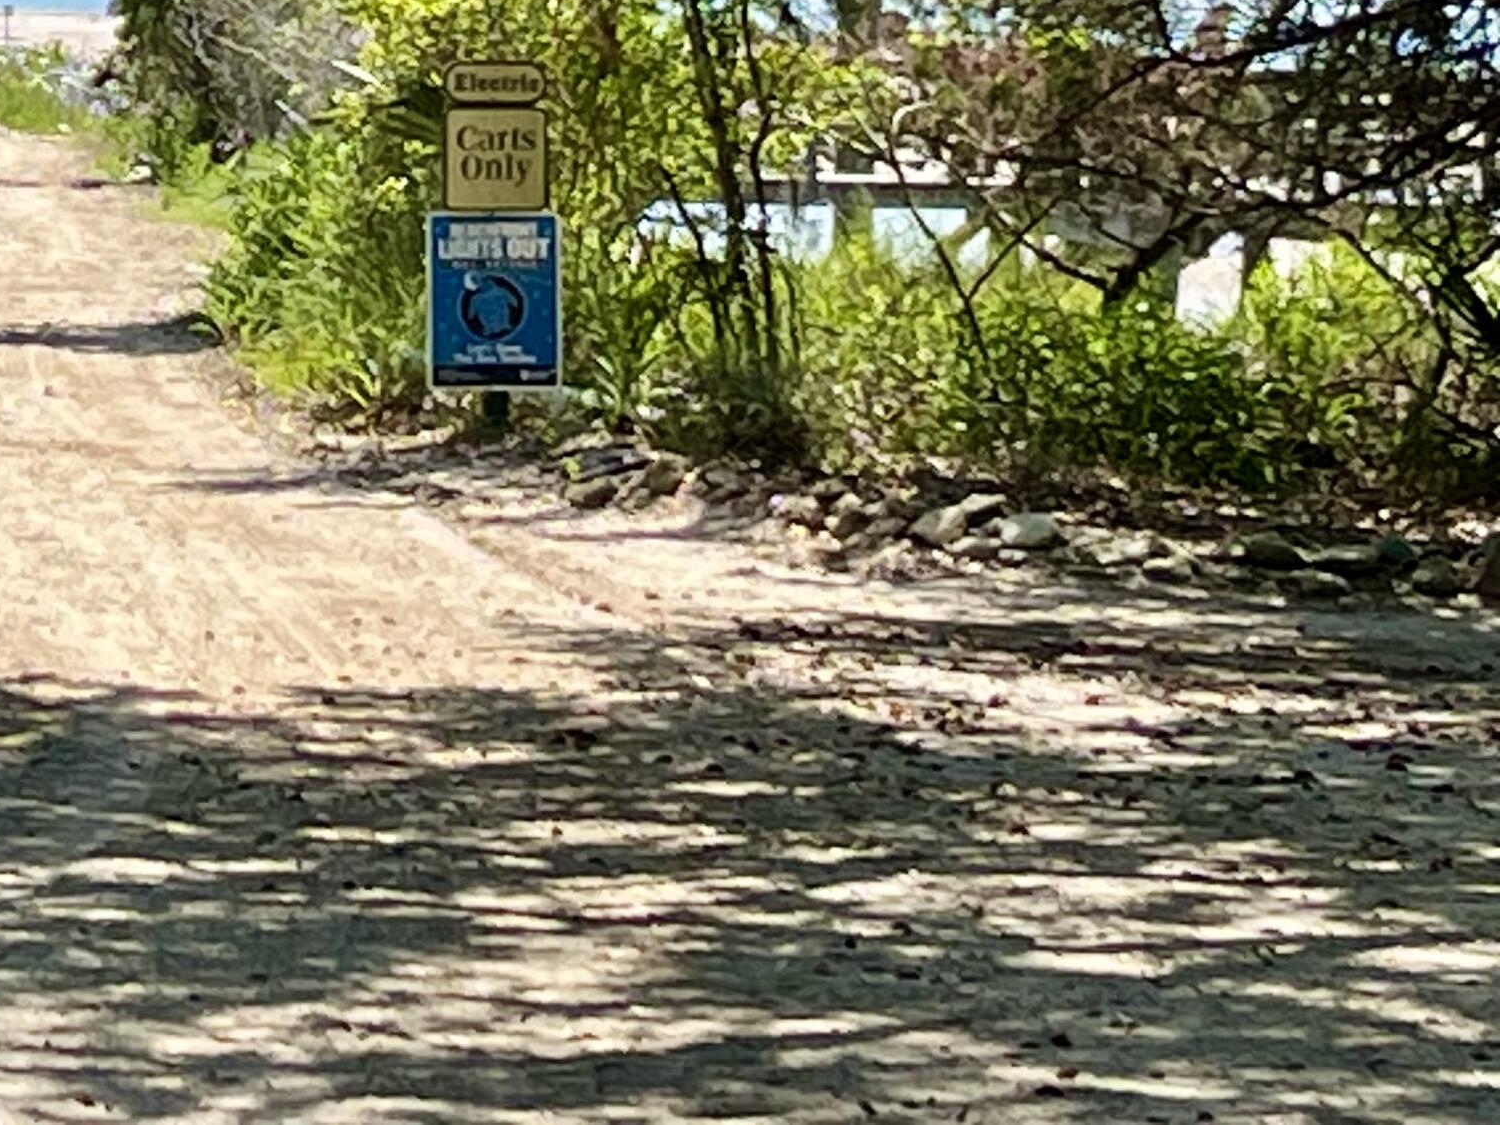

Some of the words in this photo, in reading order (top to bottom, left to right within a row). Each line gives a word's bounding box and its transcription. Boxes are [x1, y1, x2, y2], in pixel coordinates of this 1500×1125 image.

[456, 125, 536, 152] Carts
[460, 154, 533, 187] Only
[506, 237, 551, 260] OUT
